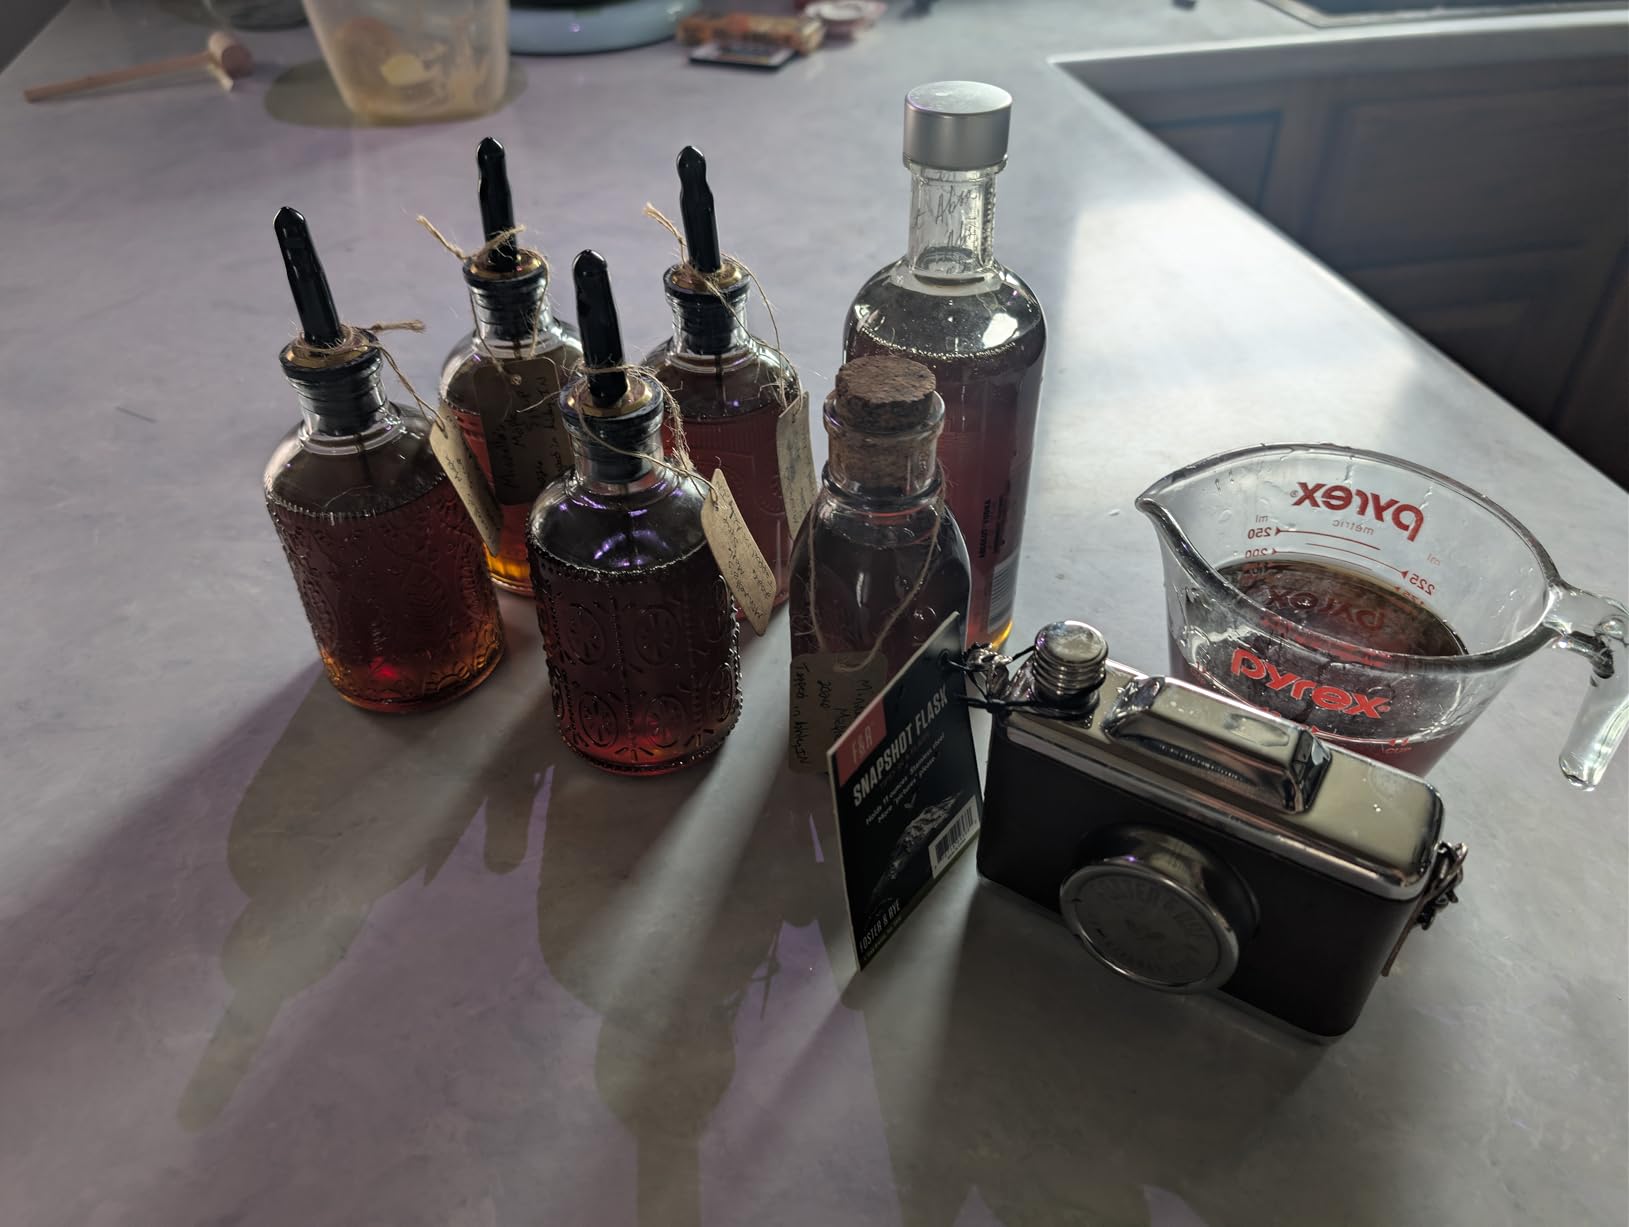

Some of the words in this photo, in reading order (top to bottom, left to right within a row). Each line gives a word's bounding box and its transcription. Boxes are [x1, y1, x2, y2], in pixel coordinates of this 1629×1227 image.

[1231, 647, 1391, 719] pyrex
[852, 722, 913, 807] SNAPSHOT
[915, 683, 948, 736] FLASK
